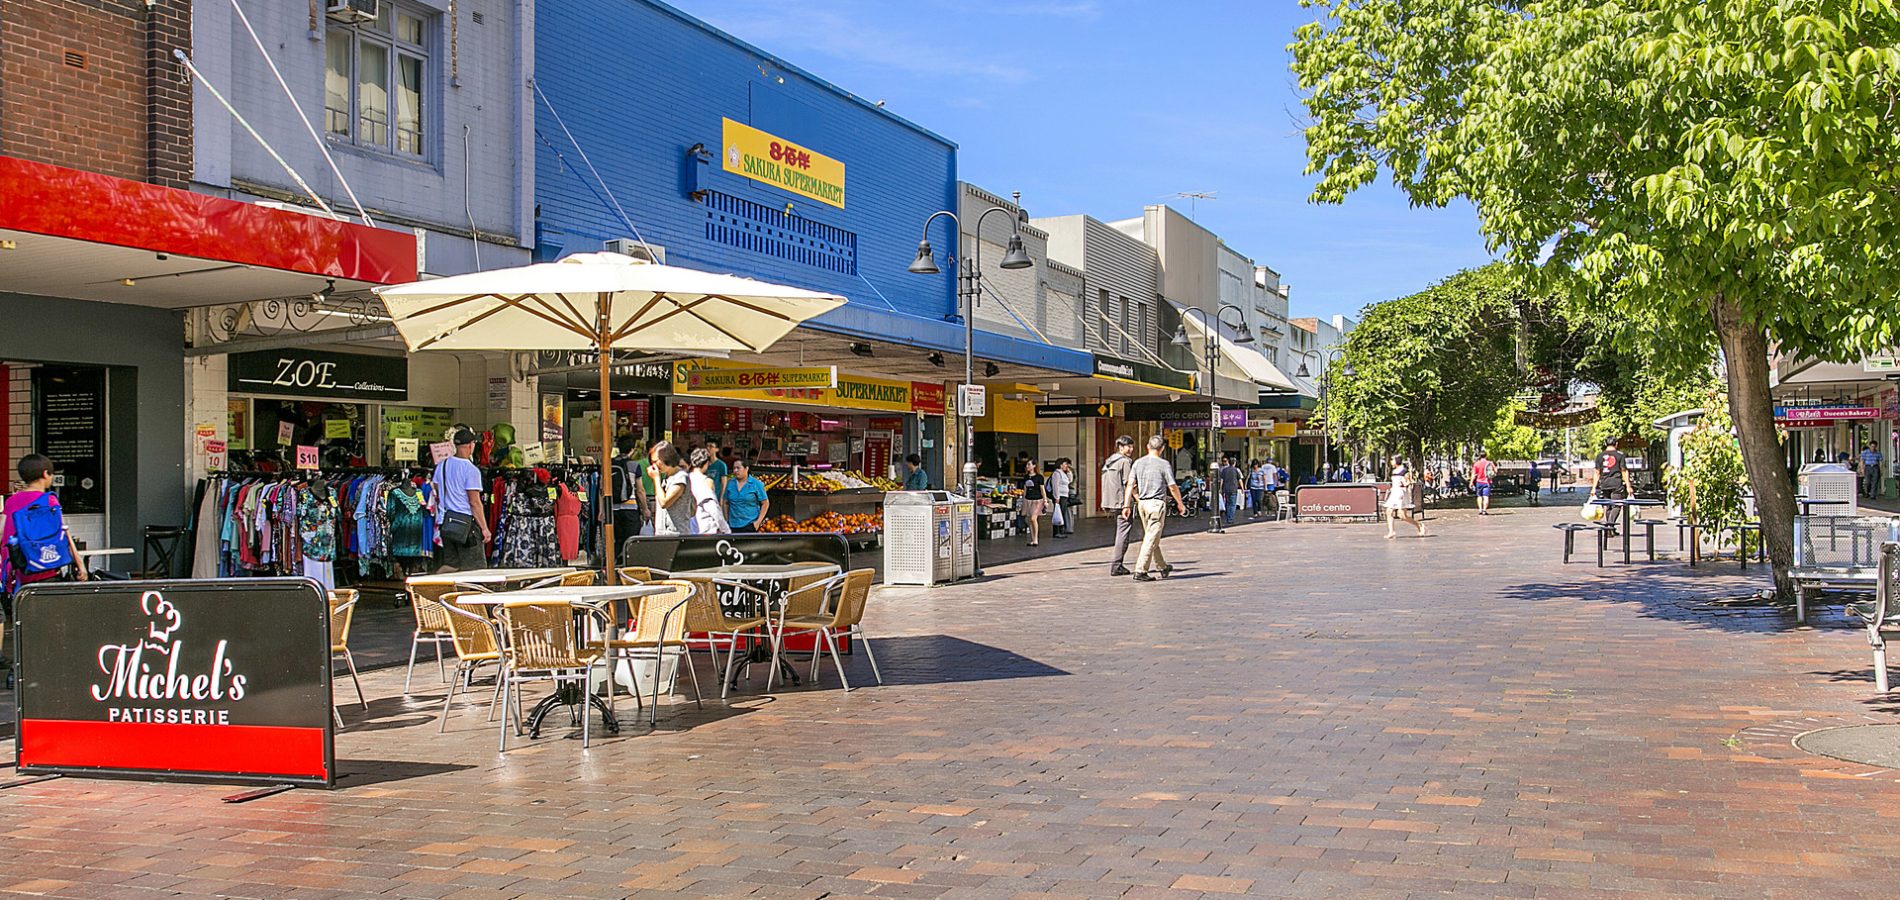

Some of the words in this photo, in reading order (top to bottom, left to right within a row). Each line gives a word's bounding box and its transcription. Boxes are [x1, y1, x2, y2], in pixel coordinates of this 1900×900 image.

[743, 153, 782, 182] SAKURA
[783, 167, 843, 204] SUPERMARKET
[272, 357, 337, 389] ZOE
[354, 381, 385, 392] Collections
[704, 375, 736, 385] SAKURA
[782, 372, 829, 383] SUPERMARKET
[835, 380, 908, 403] SUPERMARKET
[1181, 407, 1210, 419] centro
[1848, 410, 1871, 418] Bakery
[208, 456, 220, 467] 10
[299, 453, 317, 464] $10
[1323, 503, 1352, 512] centro
[91, 638, 246, 701] Michel's
[109, 707, 229, 726] PATISSERIE
